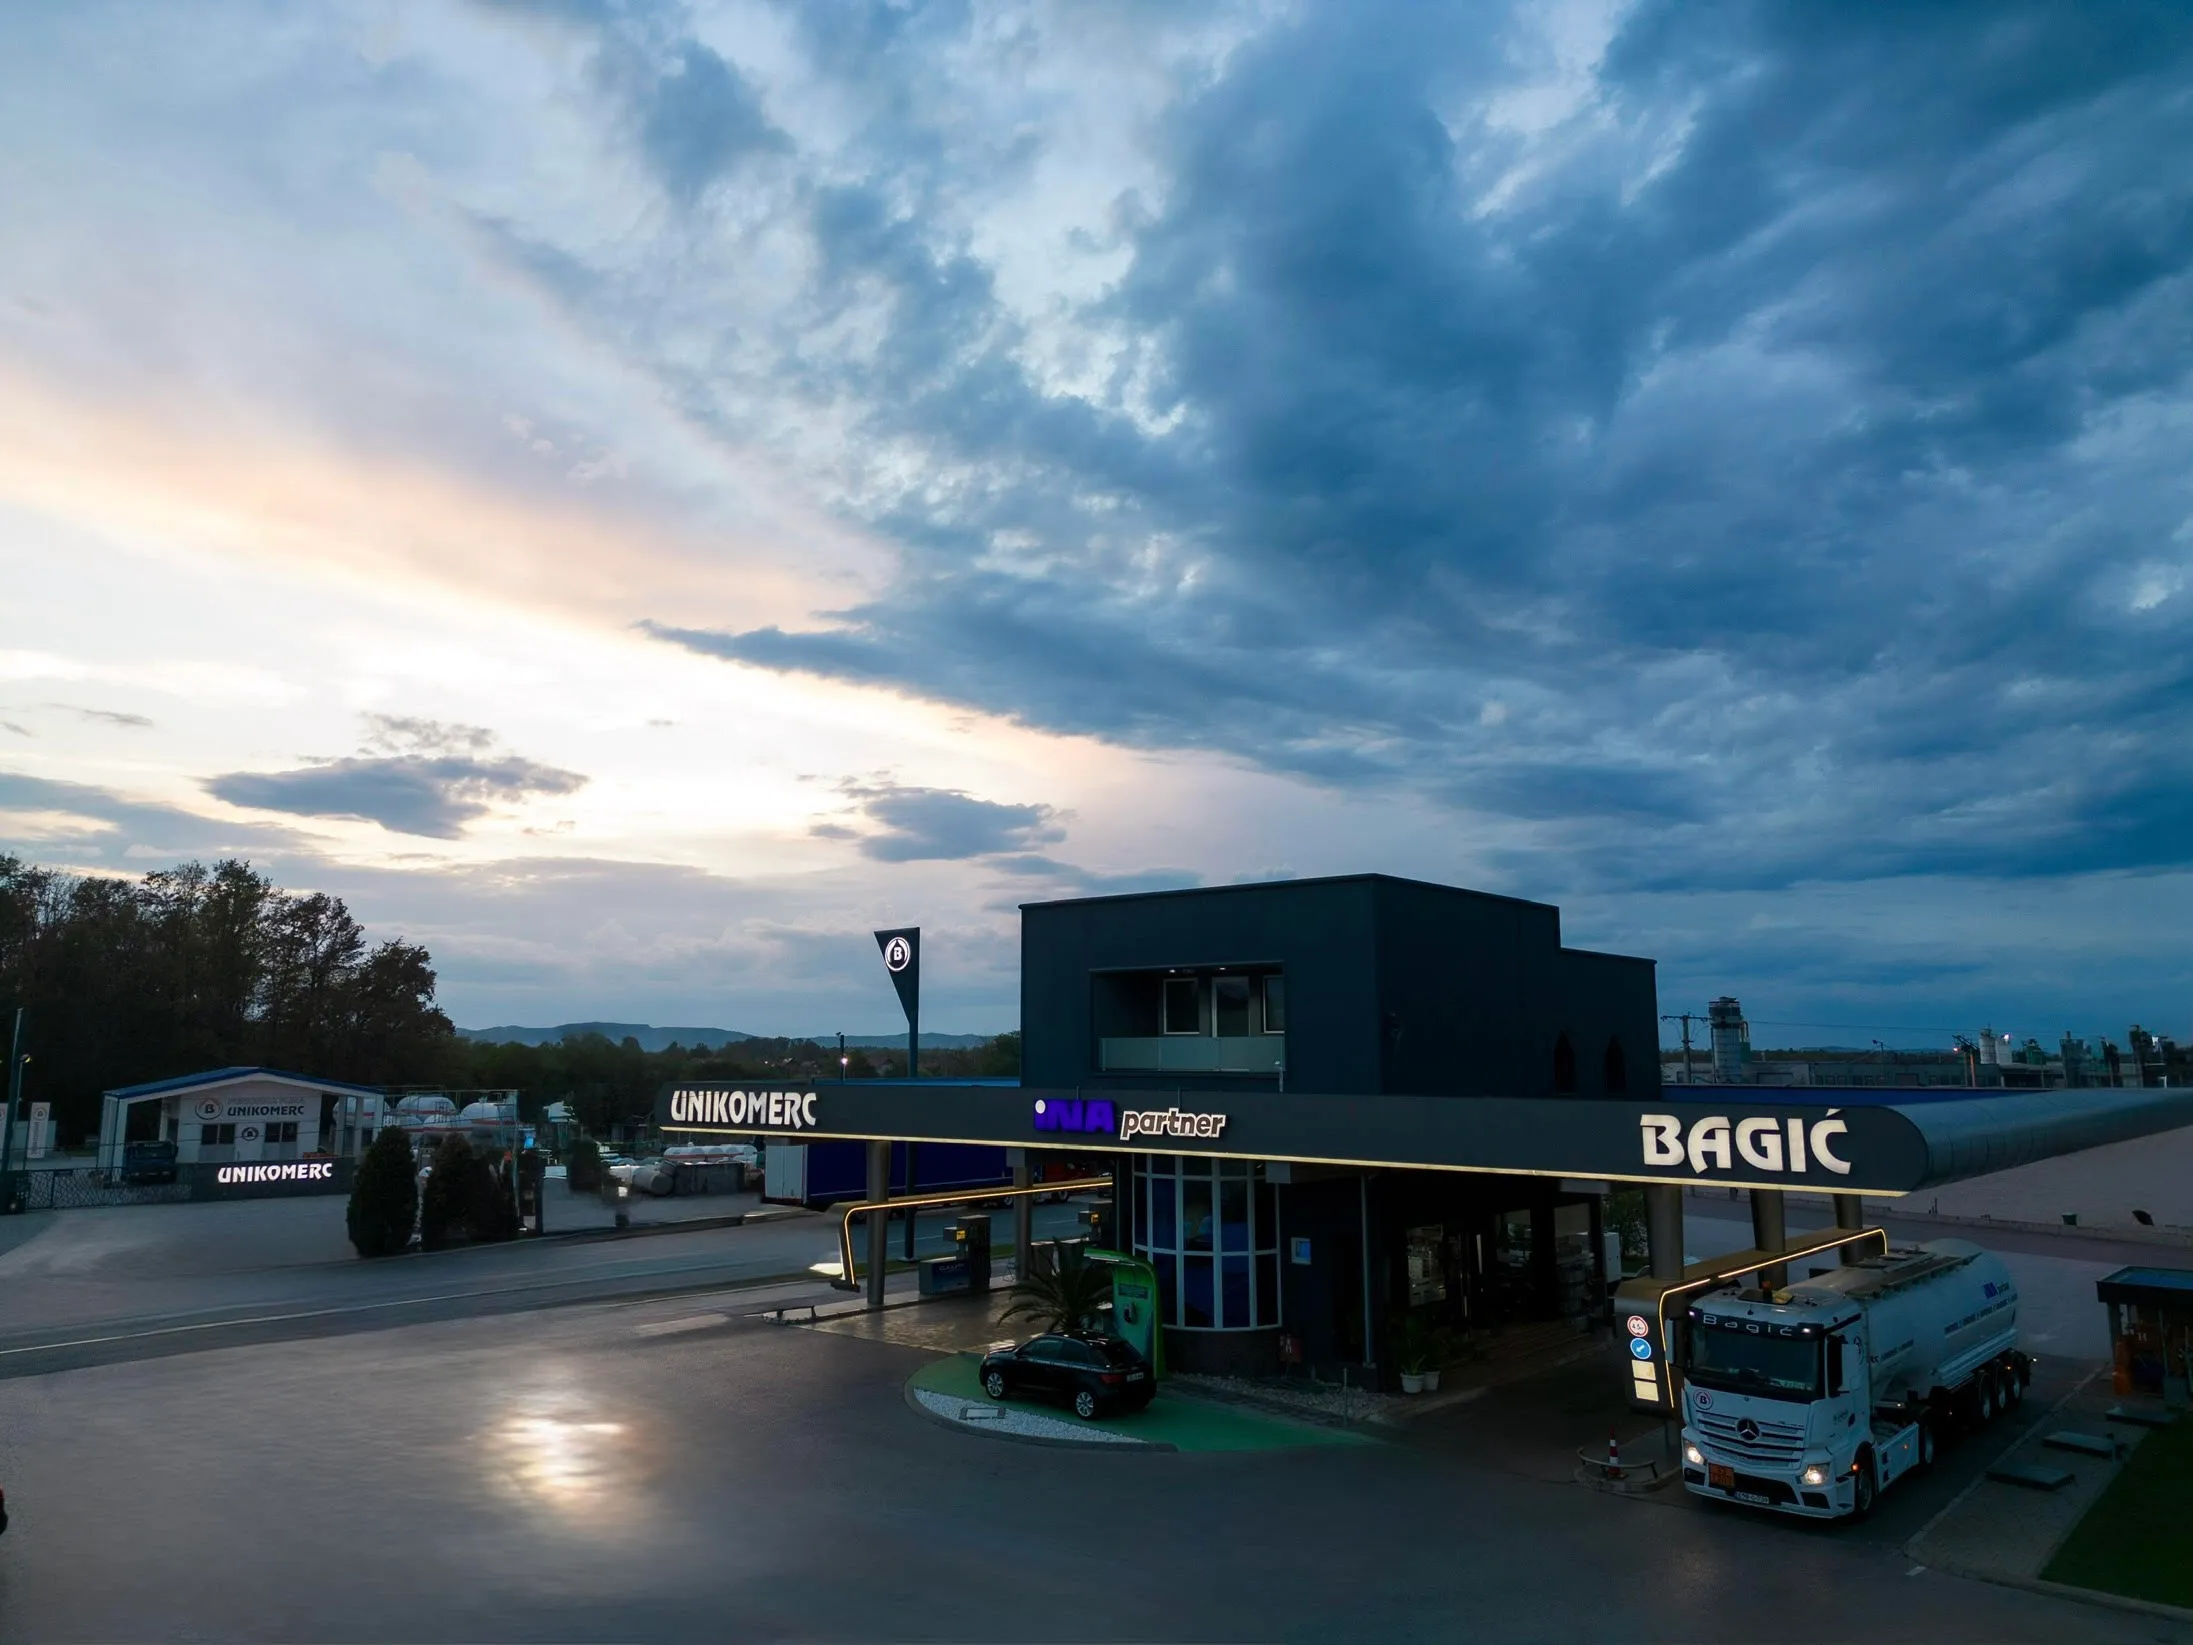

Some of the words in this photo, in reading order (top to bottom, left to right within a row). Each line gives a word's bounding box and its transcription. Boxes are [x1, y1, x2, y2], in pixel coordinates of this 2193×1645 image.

[893, 946, 904, 961] B
[227, 1105, 306, 1117] UNIKOMERC
[671, 1090, 817, 1130] UNIKOMERC
[1120, 1107, 1227, 1141] partner
[1640, 1108, 1852, 1175] BAGIĆ
[217, 1162, 333, 1184] UNIKOMERC
[1702, 1313, 1793, 1337] Bagić
[1699, 1394, 1708, 1405] B
